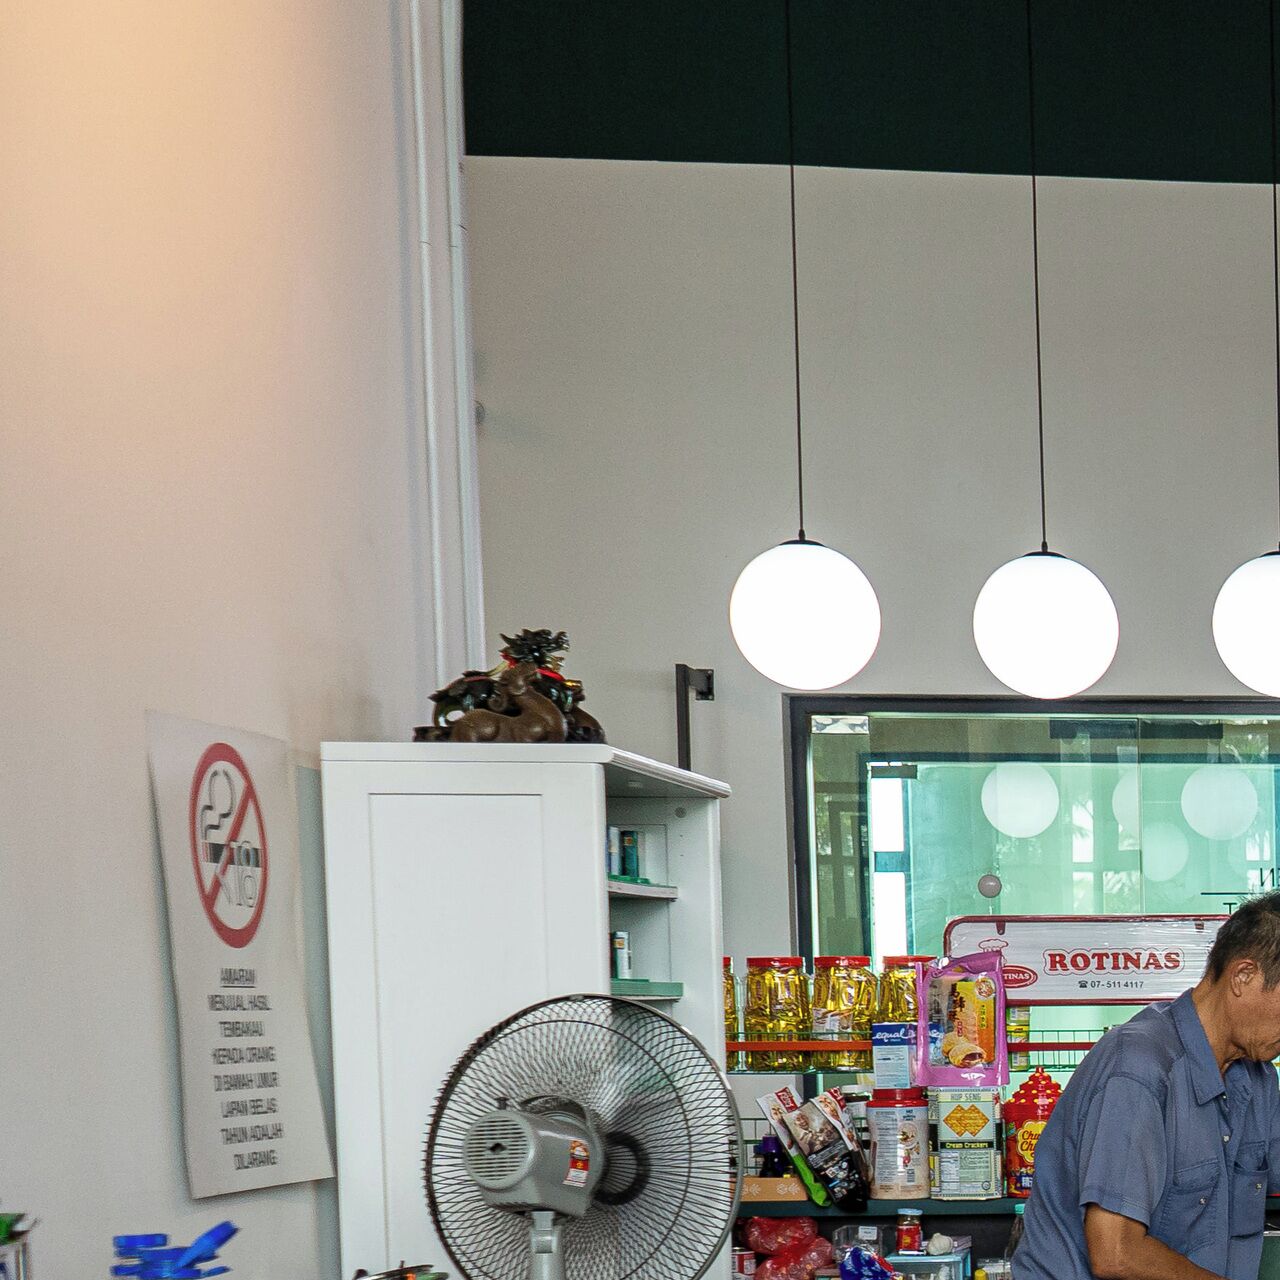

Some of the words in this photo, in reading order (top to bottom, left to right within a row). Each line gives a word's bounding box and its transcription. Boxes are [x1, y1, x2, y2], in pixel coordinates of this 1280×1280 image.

[1048, 952, 1181, 971] ROTINAS
[874, 1026, 909, 1041] equal
[946, 1141, 963, 1149] Cream
[964, 1141, 989, 1149] Crackers
